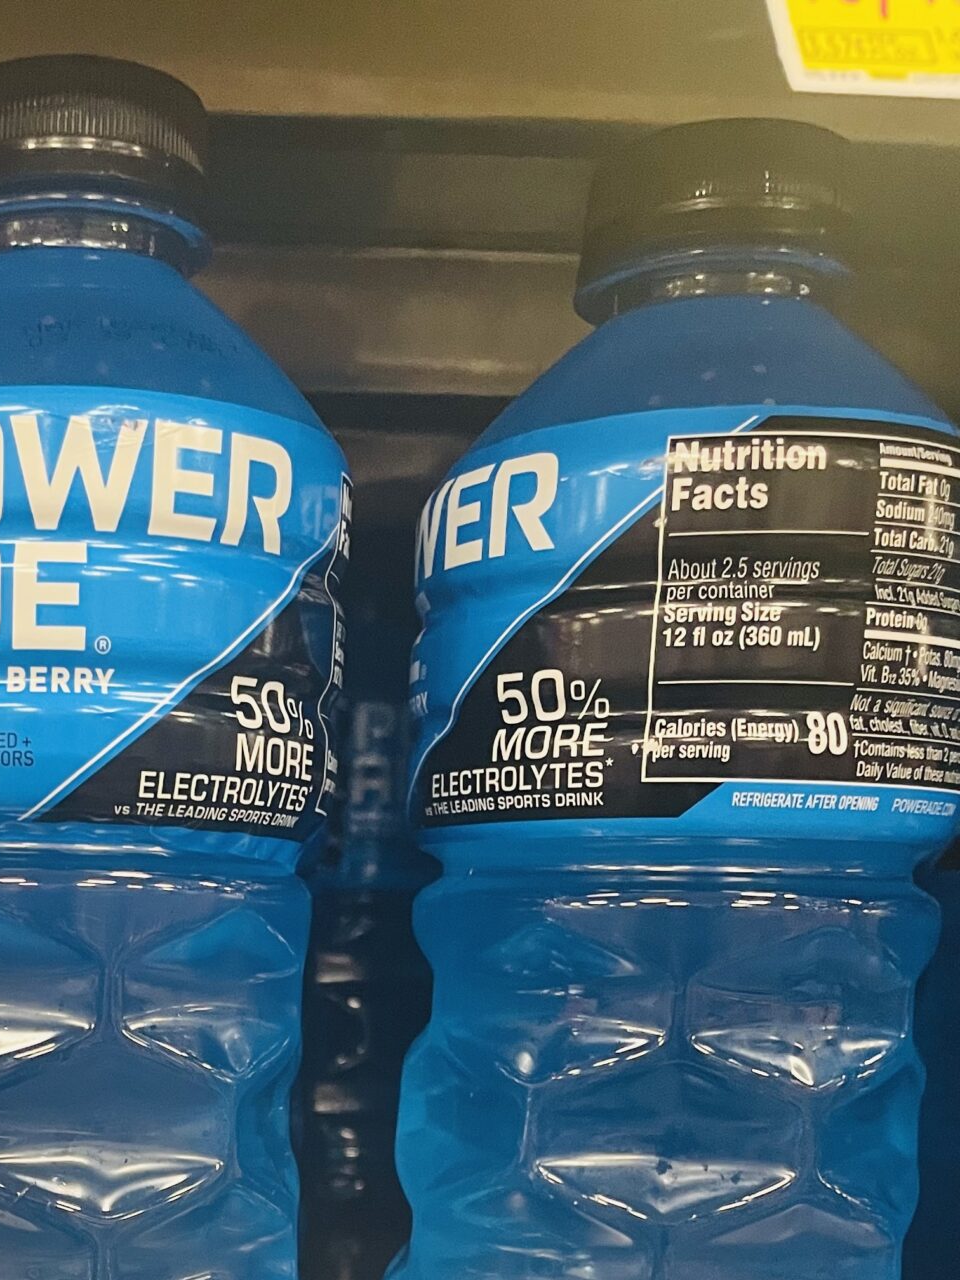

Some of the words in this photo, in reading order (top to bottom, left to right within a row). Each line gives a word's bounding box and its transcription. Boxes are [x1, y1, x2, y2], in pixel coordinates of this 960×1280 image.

[672, 438, 827, 473] Nutrition
[671, 477, 769, 511] Facts
[668, 557, 716, 580] About
[722, 557, 747, 578] 2.5
[752, 557, 821, 583] servings
[666, 584, 694, 604] per
[698, 582, 774, 600] container
[664, 604, 736, 626] Serving
[741, 602, 782, 622] Size
[663, 629, 687, 647] 12
[693, 628, 705, 647] fl
[712, 631, 733, 647] oz
[739, 627, 782, 650] (360
[787, 627, 821, 650] mL)
[6, 666, 115, 695] BERRY
[230, 675, 313, 739] 50%
[497, 669, 610, 724] 50%
[492, 723, 608, 762] MORE
[655, 718, 726, 738] Calories
[731, 718, 799, 743] (Energy)
[806, 711, 848, 755] 80
[235, 733, 314, 781] MORE
[680, 741, 731, 761] serving
[433, 803, 449, 815] THE
[451, 798, 495, 814] LEADING
[498, 795, 551, 810] SPORTS
[556, 792, 603, 807] DRINK
[732, 791, 803, 808] REFRIGERATE
[805, 793, 836, 810] AFTER
[838, 796, 879, 811] OPENING
[114, 805, 130, 815] vs
[136, 803, 165, 817] THE
[168, 805, 227, 821] LEADING
[229, 809, 271, 825] SPORTS
[271, 812, 299, 829] DRINK
